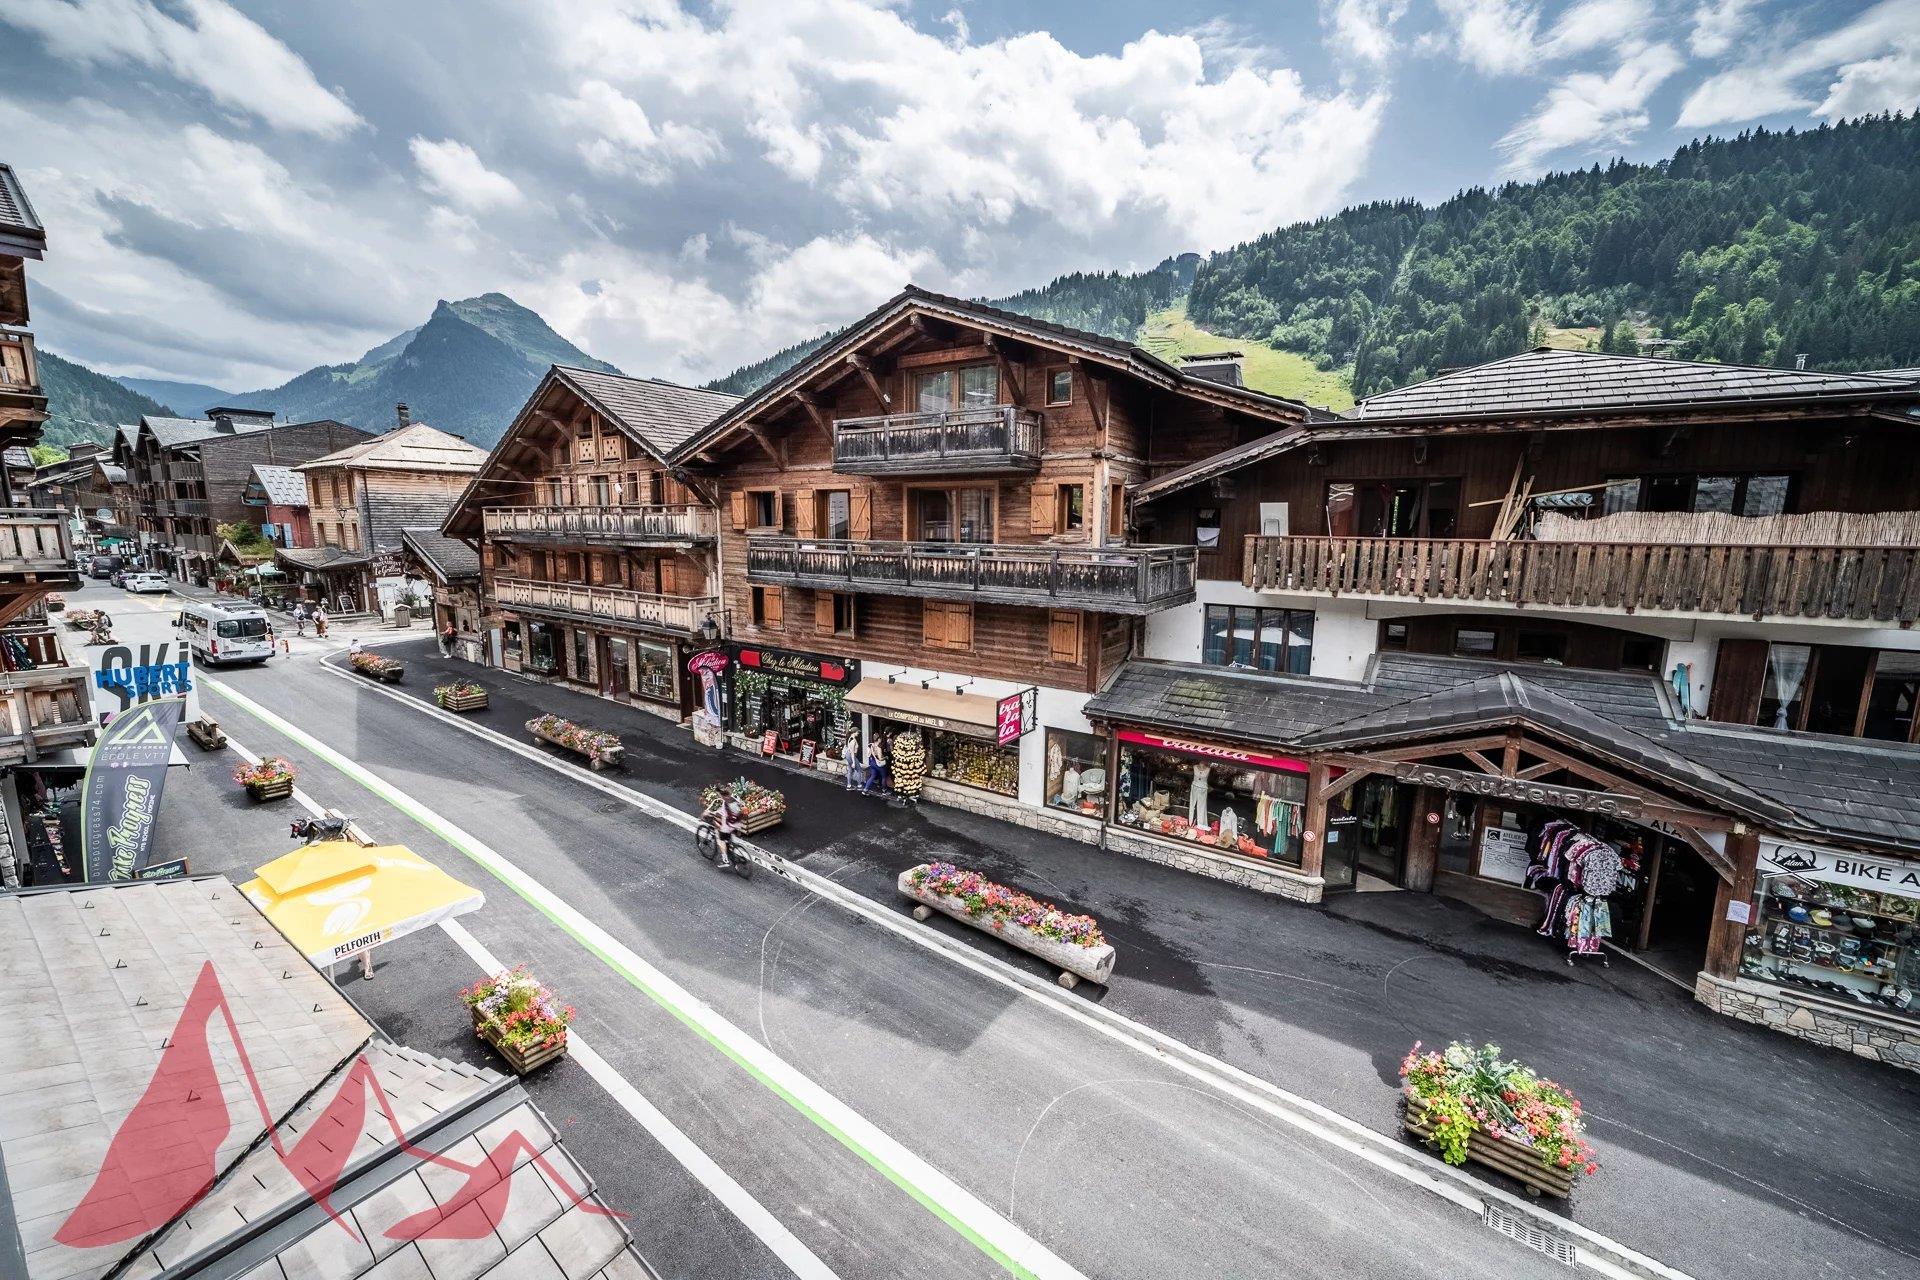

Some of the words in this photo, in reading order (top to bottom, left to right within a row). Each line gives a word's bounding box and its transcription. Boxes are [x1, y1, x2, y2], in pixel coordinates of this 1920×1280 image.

[95, 662, 191, 689] HUBERT
[127, 679, 193, 698] SPORTS
[144, 752, 165, 760] VTT
[1835, 860, 1893, 882] BIKE
[334, 931, 381, 956] PELFORTH
